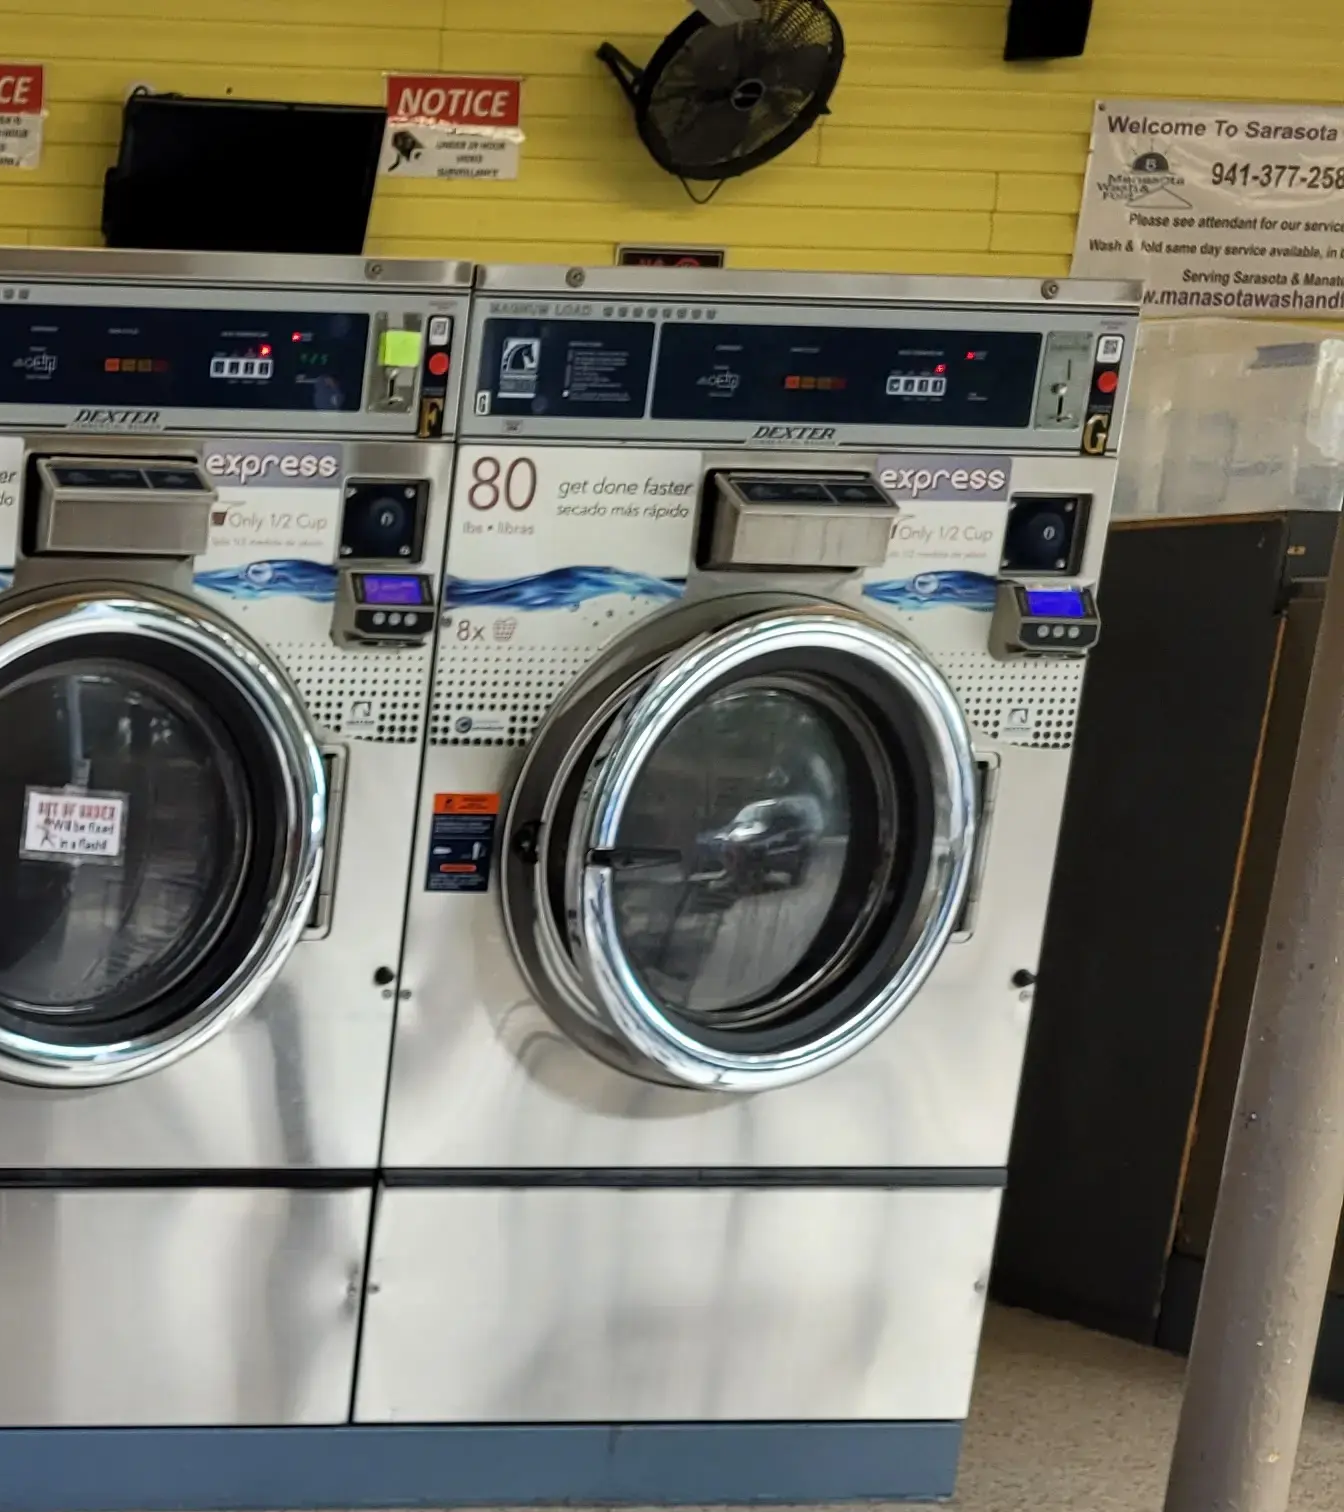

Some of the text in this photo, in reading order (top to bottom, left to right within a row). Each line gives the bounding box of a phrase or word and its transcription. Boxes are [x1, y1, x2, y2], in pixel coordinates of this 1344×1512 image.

[397, 87, 510, 118] NOTICE
[1107, 114, 1338, 141] Welcome To Sarasota
[1129, 213, 1170, 227] Please
[1172, 217, 1195, 228] see
[1198, 216, 1257, 230] attendant
[1260, 217, 1278, 230] for
[1280, 220, 1301, 231] our
[1089, 239, 1122, 252] Wash
[1125, 240, 1134, 252] &
[1141, 241, 1162, 254] fold
[1165, 243, 1196, 255] same
[1200, 243, 1222, 258] day
[1225, 244, 1266, 257] service
[1182, 268, 1230, 287] Serving
[1234, 270, 1287, 286] Sarasota
[1291, 272, 1299, 286] &
[73, 408, 160, 424] DEXTER
[418, 397, 443, 438] F
[752, 425, 836, 440] DEXTER
[1083, 413, 1109, 454] G
[206, 452, 338, 484] express
[467, 456, 537, 512] 80
[557, 477, 695, 498] get done faster
[880, 465, 1005, 499] express
[228, 512, 328, 533] Only 1/2 Cup
[899, 526, 993, 546] Only 1/2 Cup
[456, 620, 484, 641] 8x
